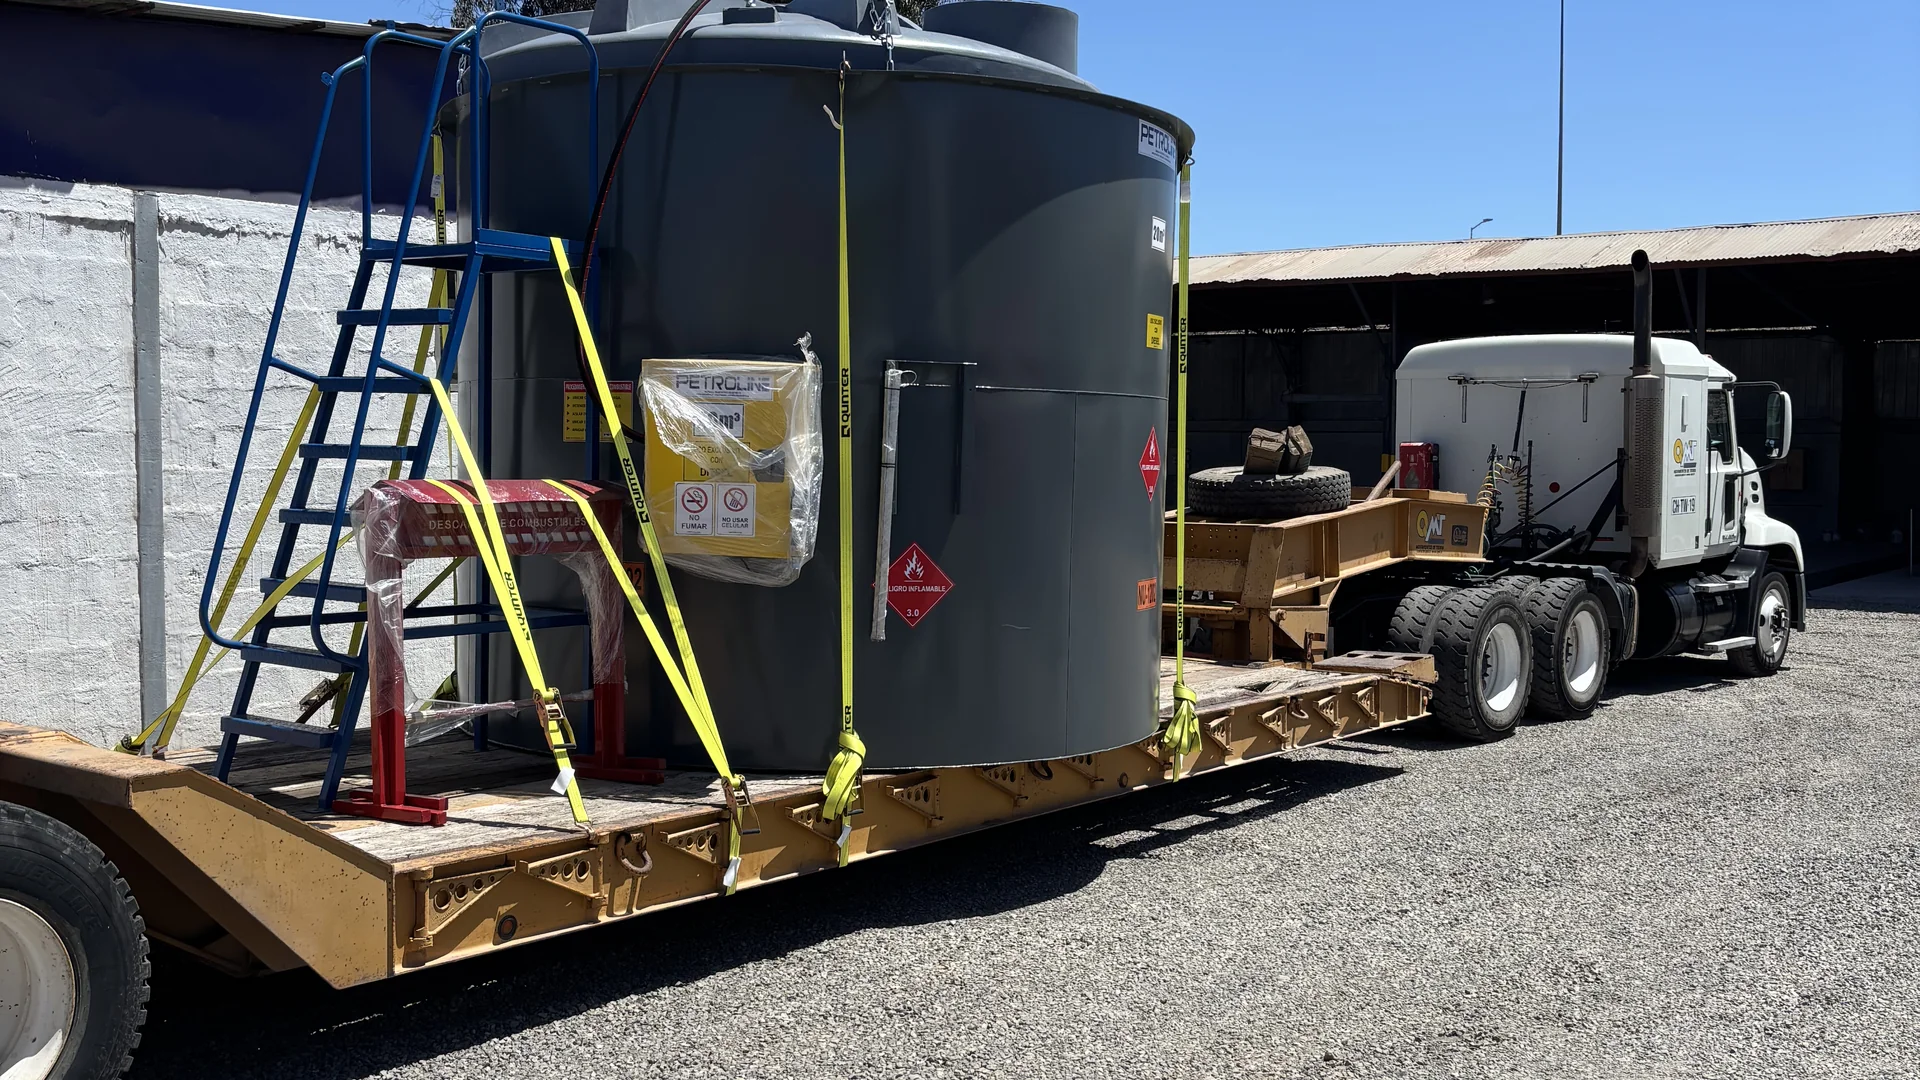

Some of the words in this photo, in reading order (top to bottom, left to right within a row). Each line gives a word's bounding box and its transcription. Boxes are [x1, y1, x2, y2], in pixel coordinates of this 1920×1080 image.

[676, 374, 770, 392] PETROLINE
[841, 367, 850, 422] QUNTER
[509, 517, 587, 528] COMBUSTIBLES
[906, 608, 919, 617] 3.0
